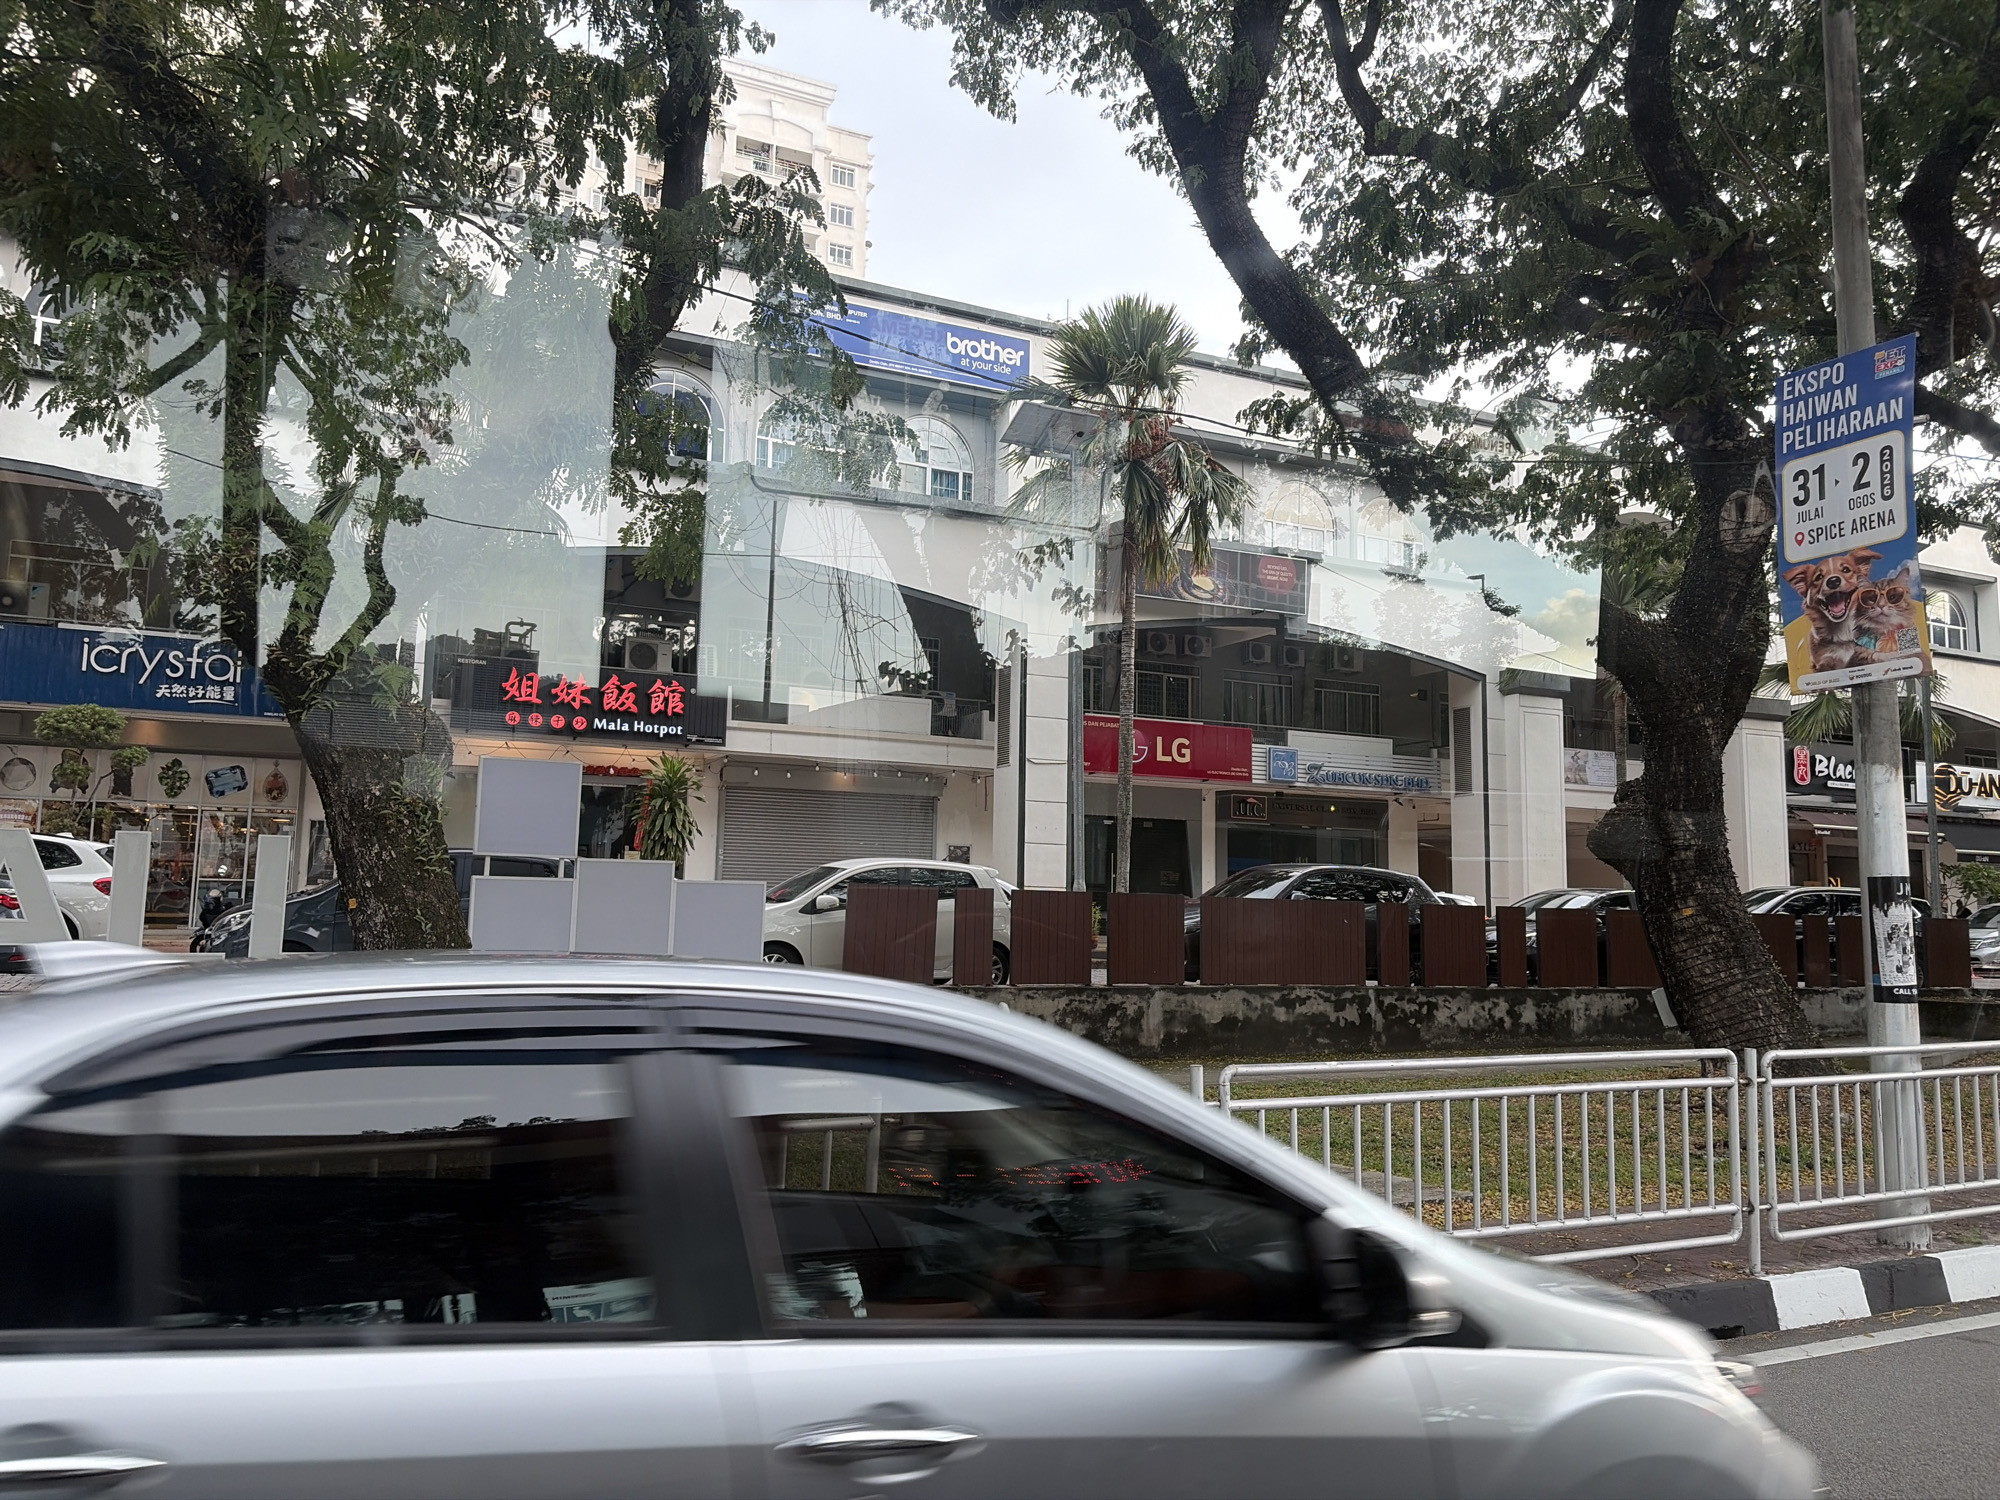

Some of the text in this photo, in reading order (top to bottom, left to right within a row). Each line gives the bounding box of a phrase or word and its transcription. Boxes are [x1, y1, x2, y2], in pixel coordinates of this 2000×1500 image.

[946, 332, 1024, 367] brother
[1874, 346, 1906, 364] PET
[960, 358, 1012, 375] at your side
[1783, 362, 1844, 401] EKSPO
[1783, 384, 1857, 427] HAIWAN
[1783, 397, 1903, 453] PELIHARAAN
[1792, 451, 1871, 506] 31 2
[1882, 449, 1892, 497] 2026
[1796, 492, 1876, 524] JULAI OGOS
[1808, 508, 1896, 546] SPICE ARENA
[457, 657, 487, 665] RESTORAN
[156, 683, 236, 701] 天然好能量
[593, 718, 683, 738] Mala Hotpot
[1156, 736, 1191, 763] LG
